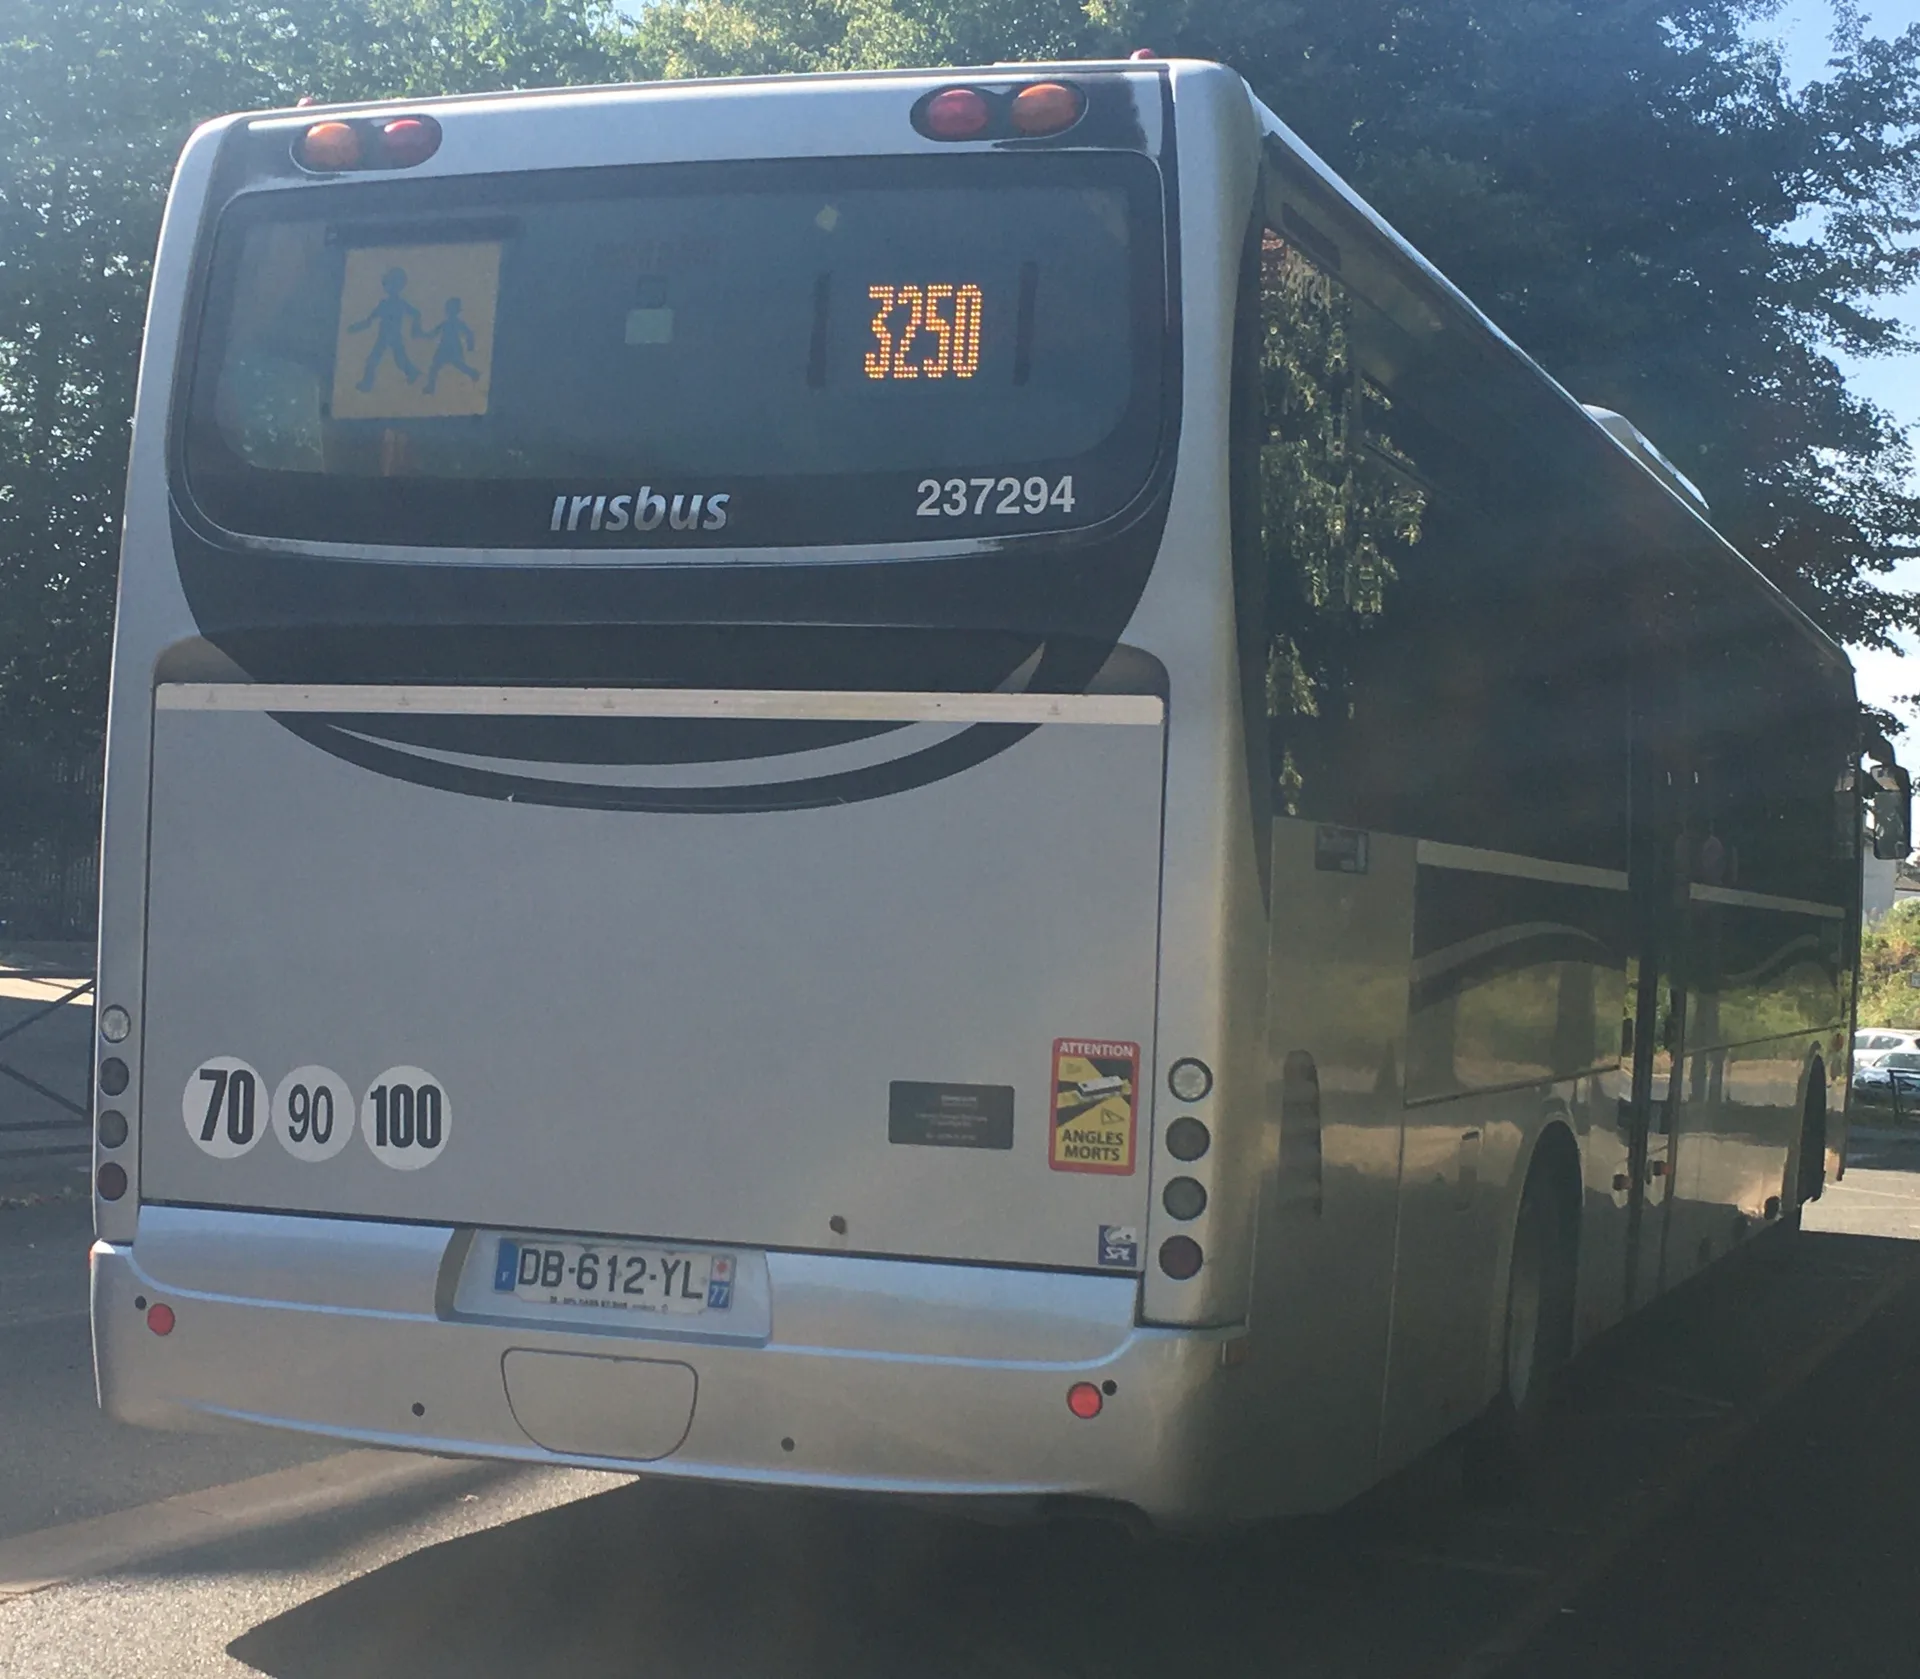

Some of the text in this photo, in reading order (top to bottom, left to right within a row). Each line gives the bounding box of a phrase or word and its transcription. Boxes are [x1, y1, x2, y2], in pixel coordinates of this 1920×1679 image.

[864, 284, 982, 379] 3250
[550, 485, 730, 532] irisbus
[916, 475, 1076, 517] 237294
[1060, 1041, 1133, 1057] ATTENTION
[199, 1068, 256, 1145] 70
[288, 1083, 334, 1144] 90
[370, 1083, 443, 1149] 100
[1062, 1129, 1124, 1146] ANGLES
[1063, 1145, 1121, 1161] MORTS
[517, 1247, 703, 1300] DB-612-YL
[709, 1284, 729, 1306] 77
